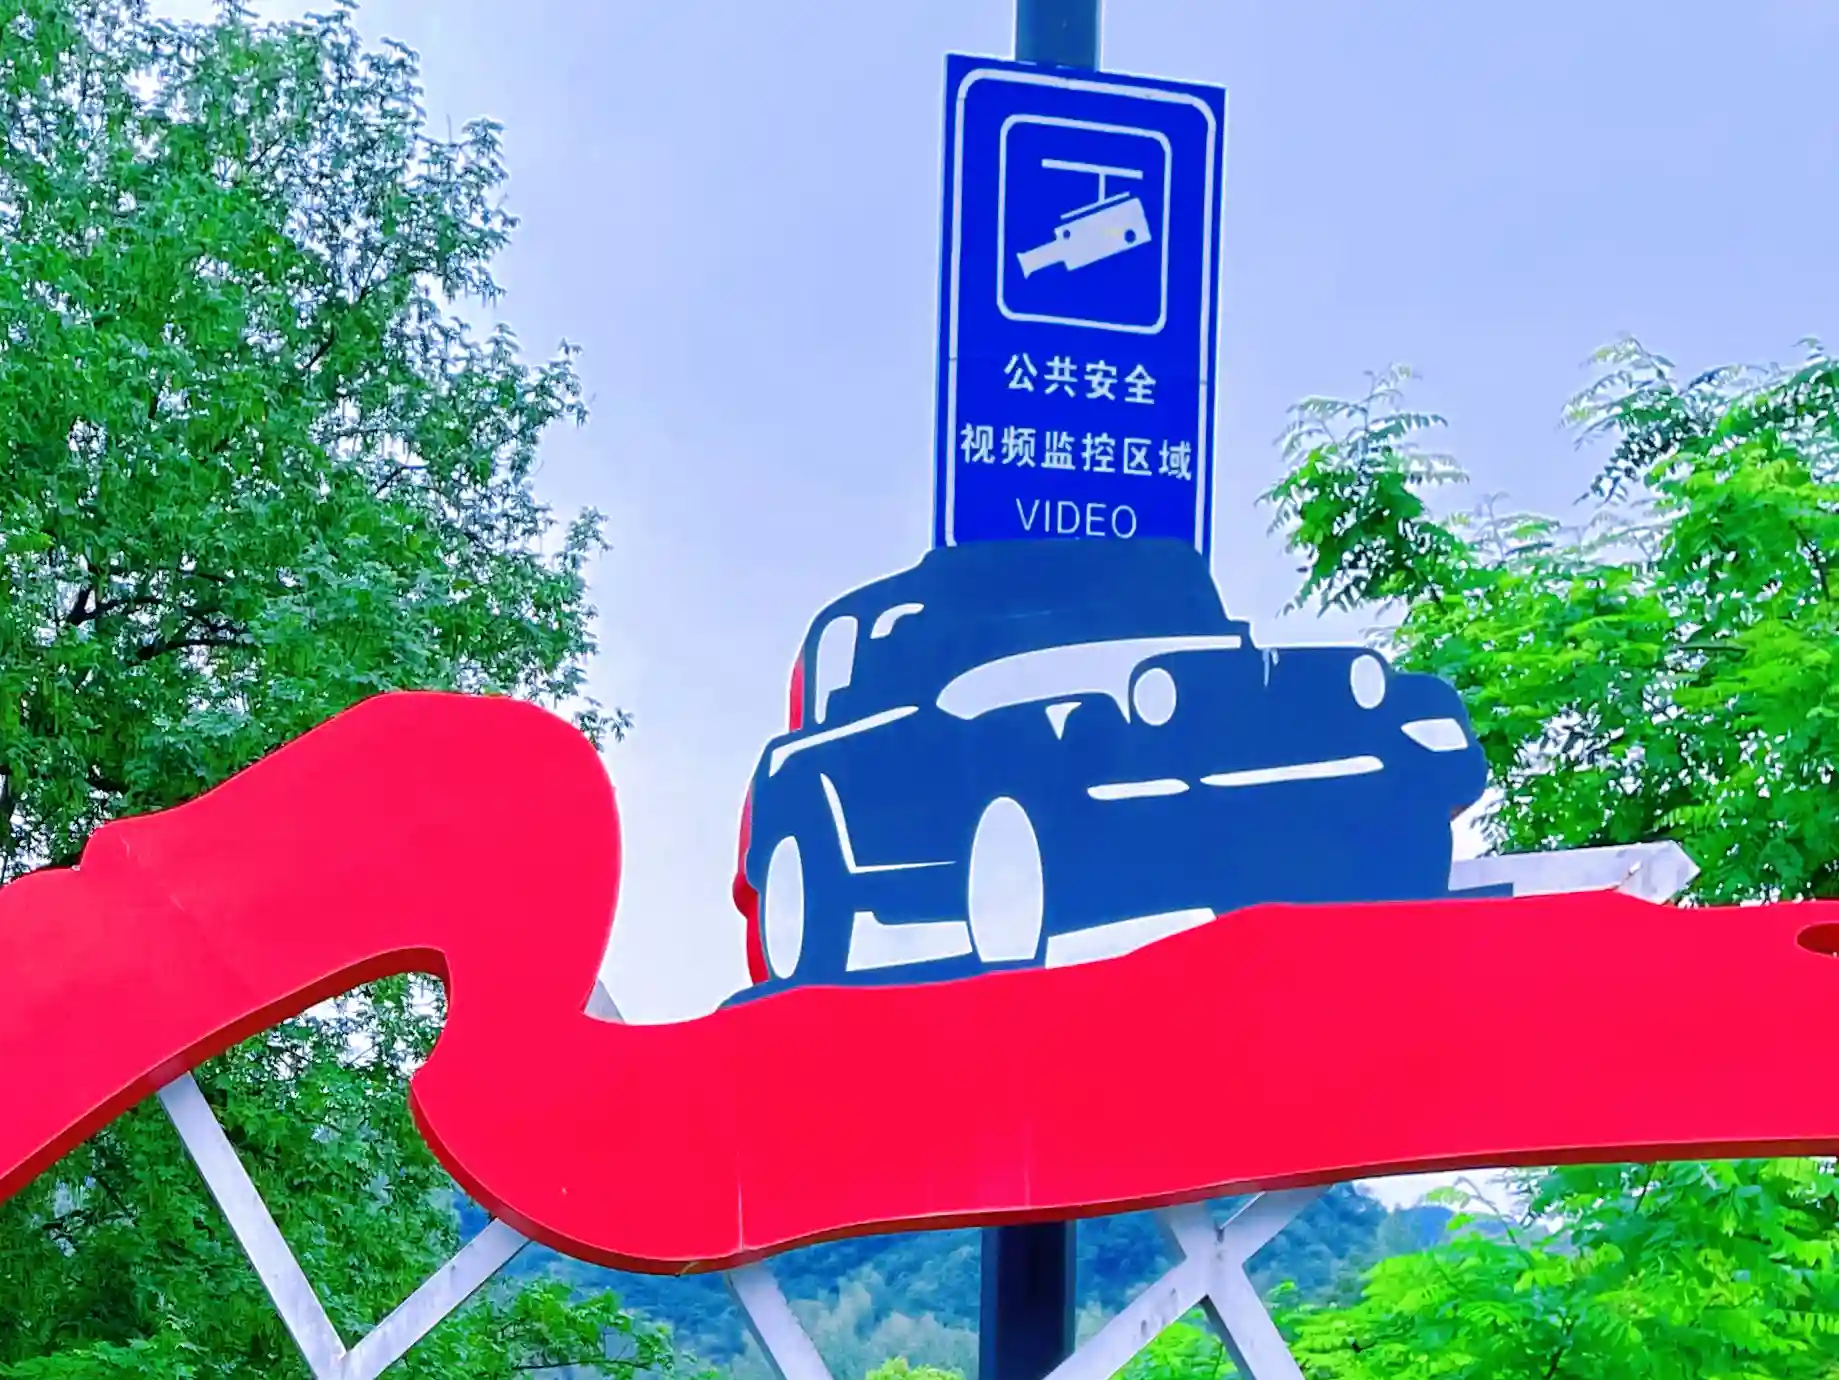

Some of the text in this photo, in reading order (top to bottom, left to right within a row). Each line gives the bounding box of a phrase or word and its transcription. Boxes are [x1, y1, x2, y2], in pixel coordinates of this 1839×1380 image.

[1004, 353, 1157, 405] 公共安全
[961, 423, 1192, 481] 视频监控区域
[1016, 498, 1138, 539] VIDEO
